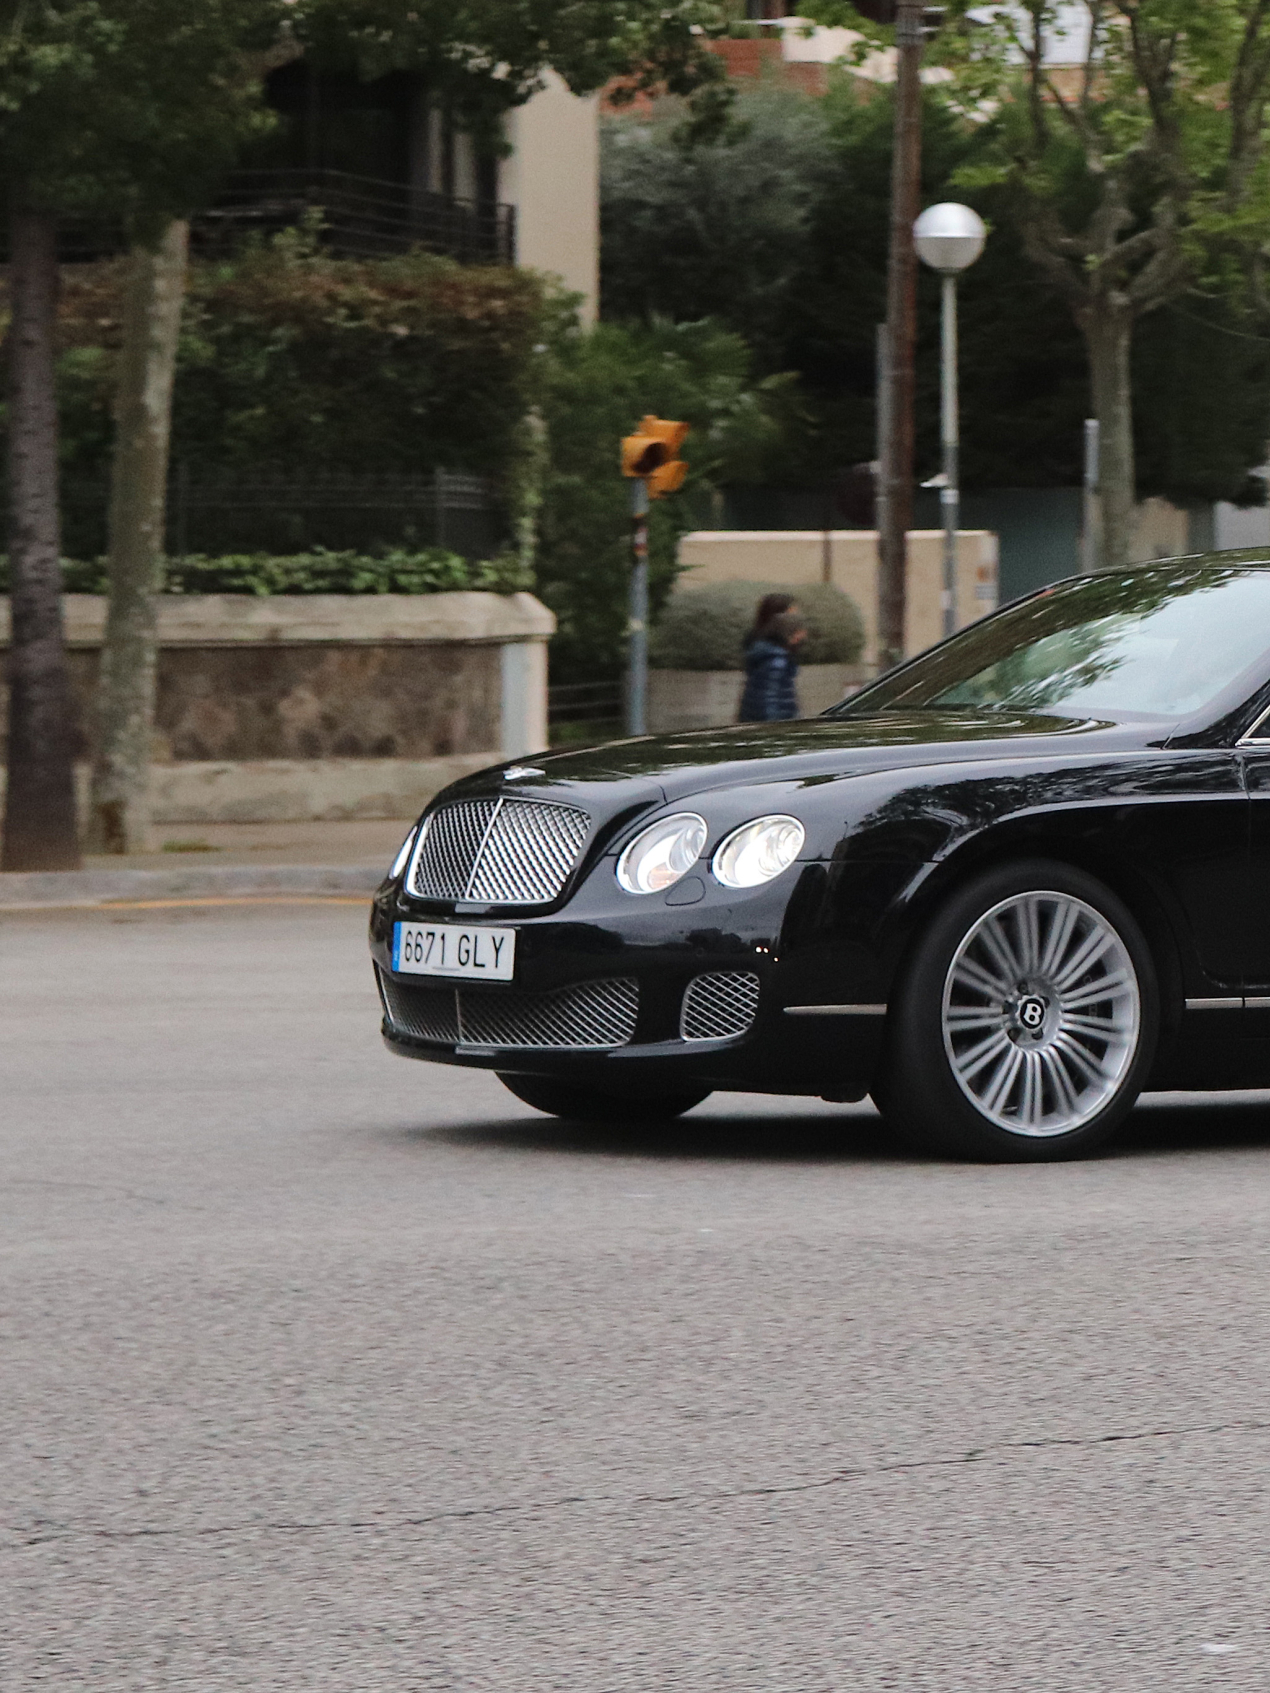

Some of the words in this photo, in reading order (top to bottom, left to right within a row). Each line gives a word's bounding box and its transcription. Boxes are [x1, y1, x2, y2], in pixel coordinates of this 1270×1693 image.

[404, 930, 446, 965] 6671
[457, 934, 505, 969] GLY
[1023, 1003, 1042, 1025] B
